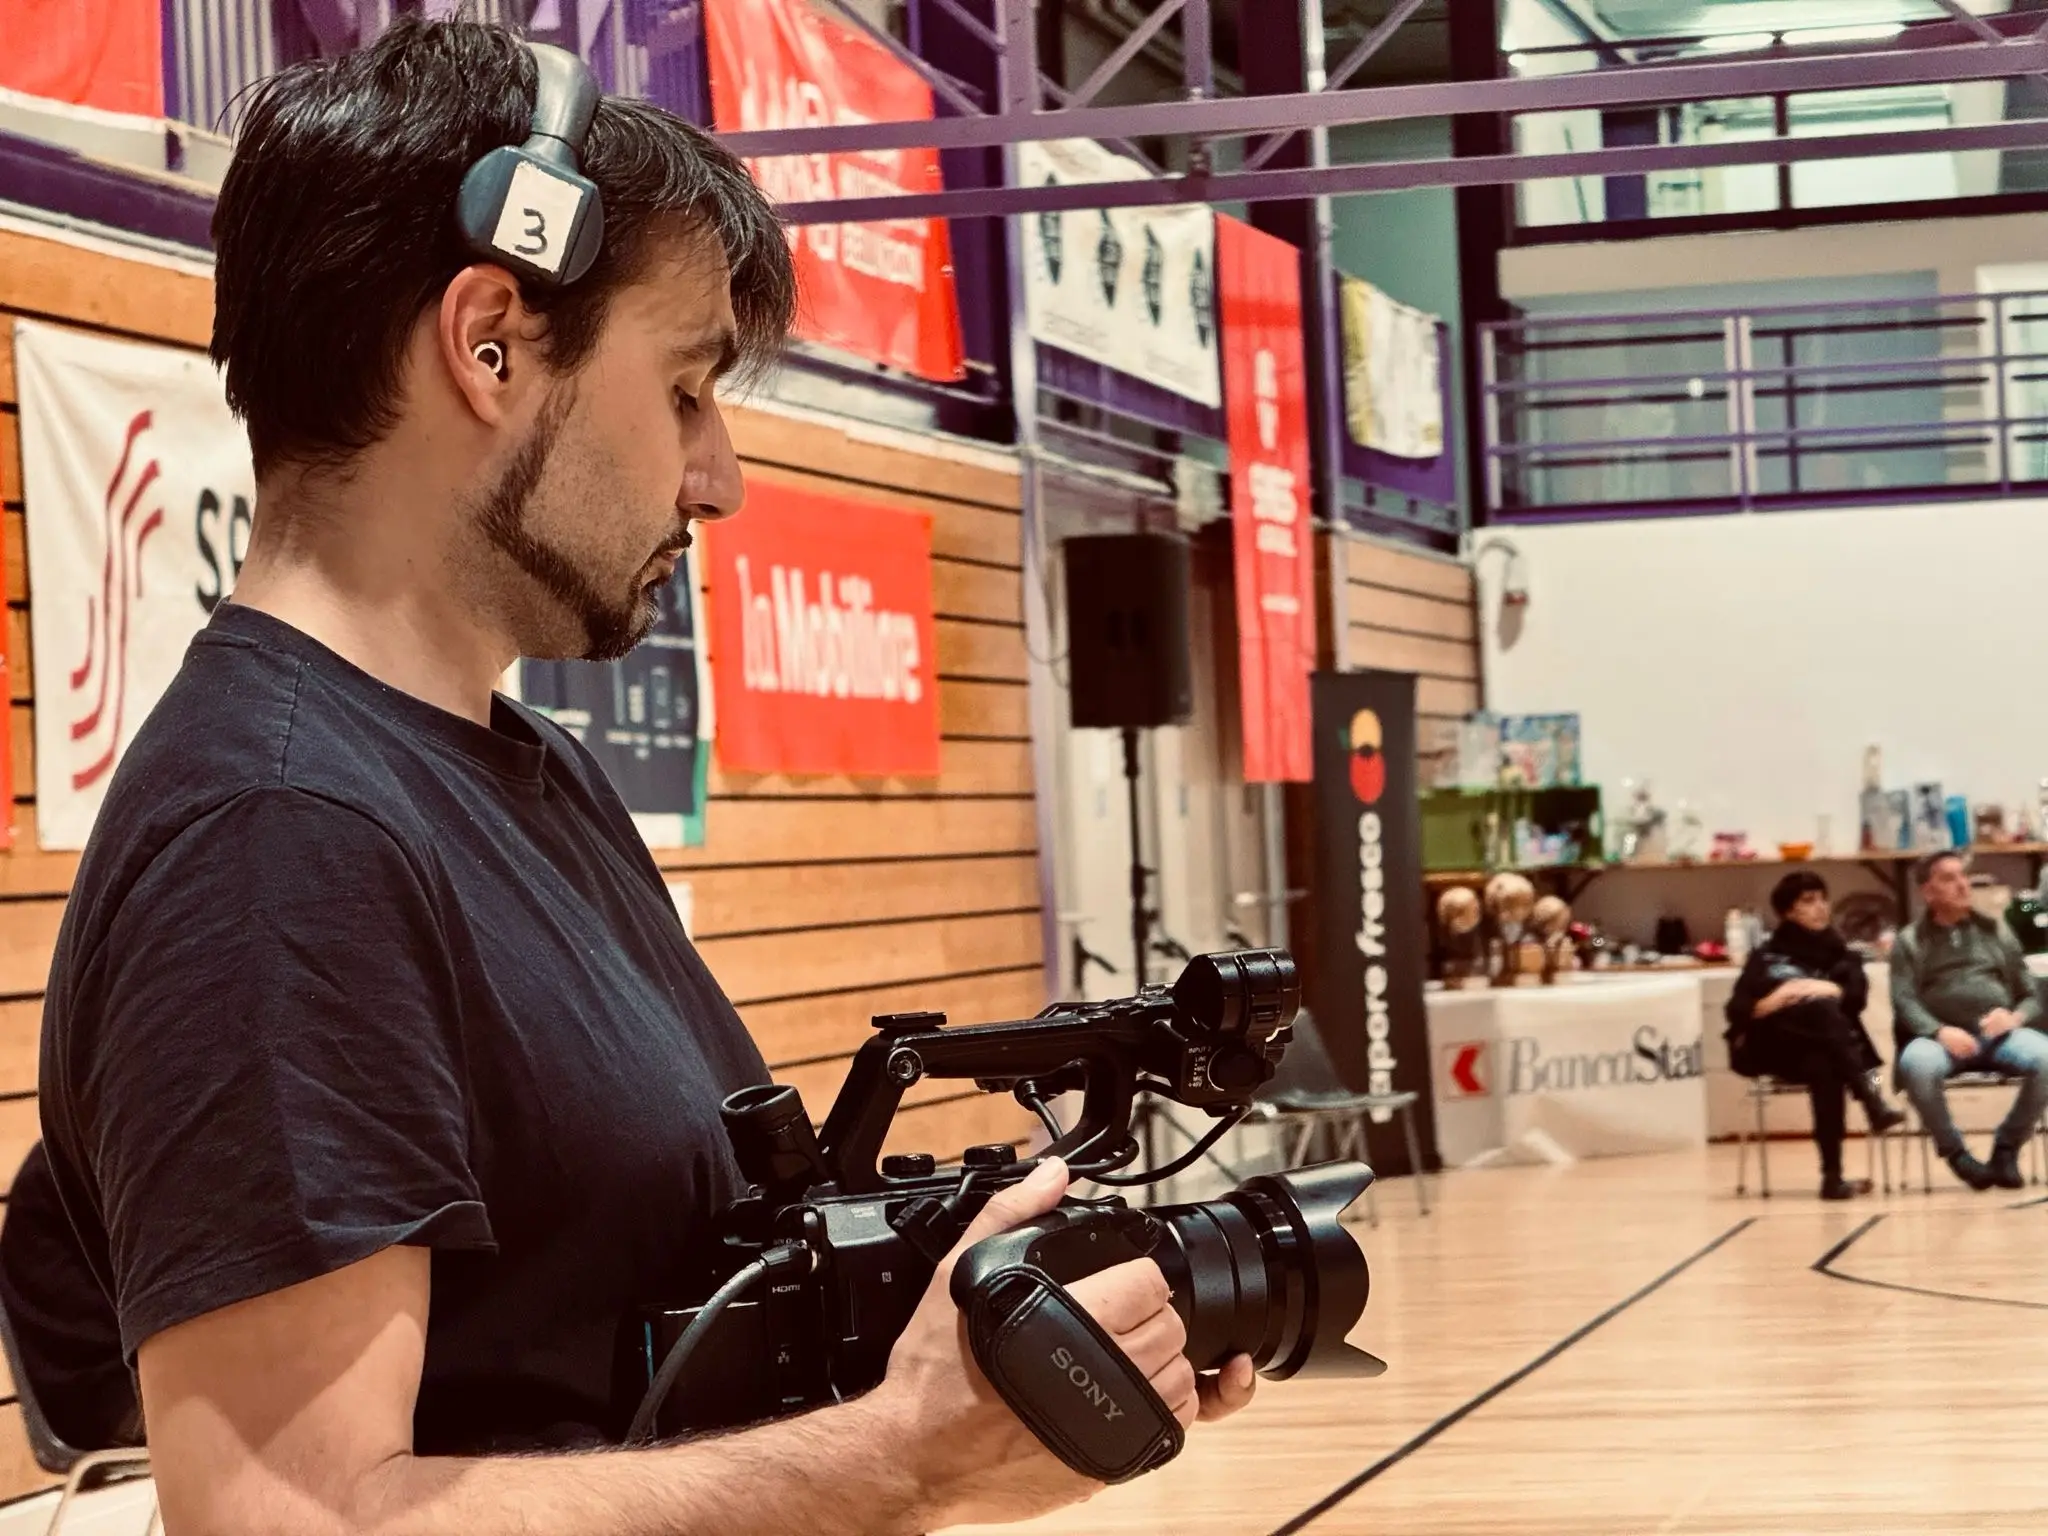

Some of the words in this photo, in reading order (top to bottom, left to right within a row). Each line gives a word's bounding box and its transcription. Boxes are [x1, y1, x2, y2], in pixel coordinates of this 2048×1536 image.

[514, 207, 548, 255] 3
[1355, 811, 1386, 957] fresco
[772, 1284, 800, 1293] HDMI
[1050, 1347, 1125, 1422] SONY
